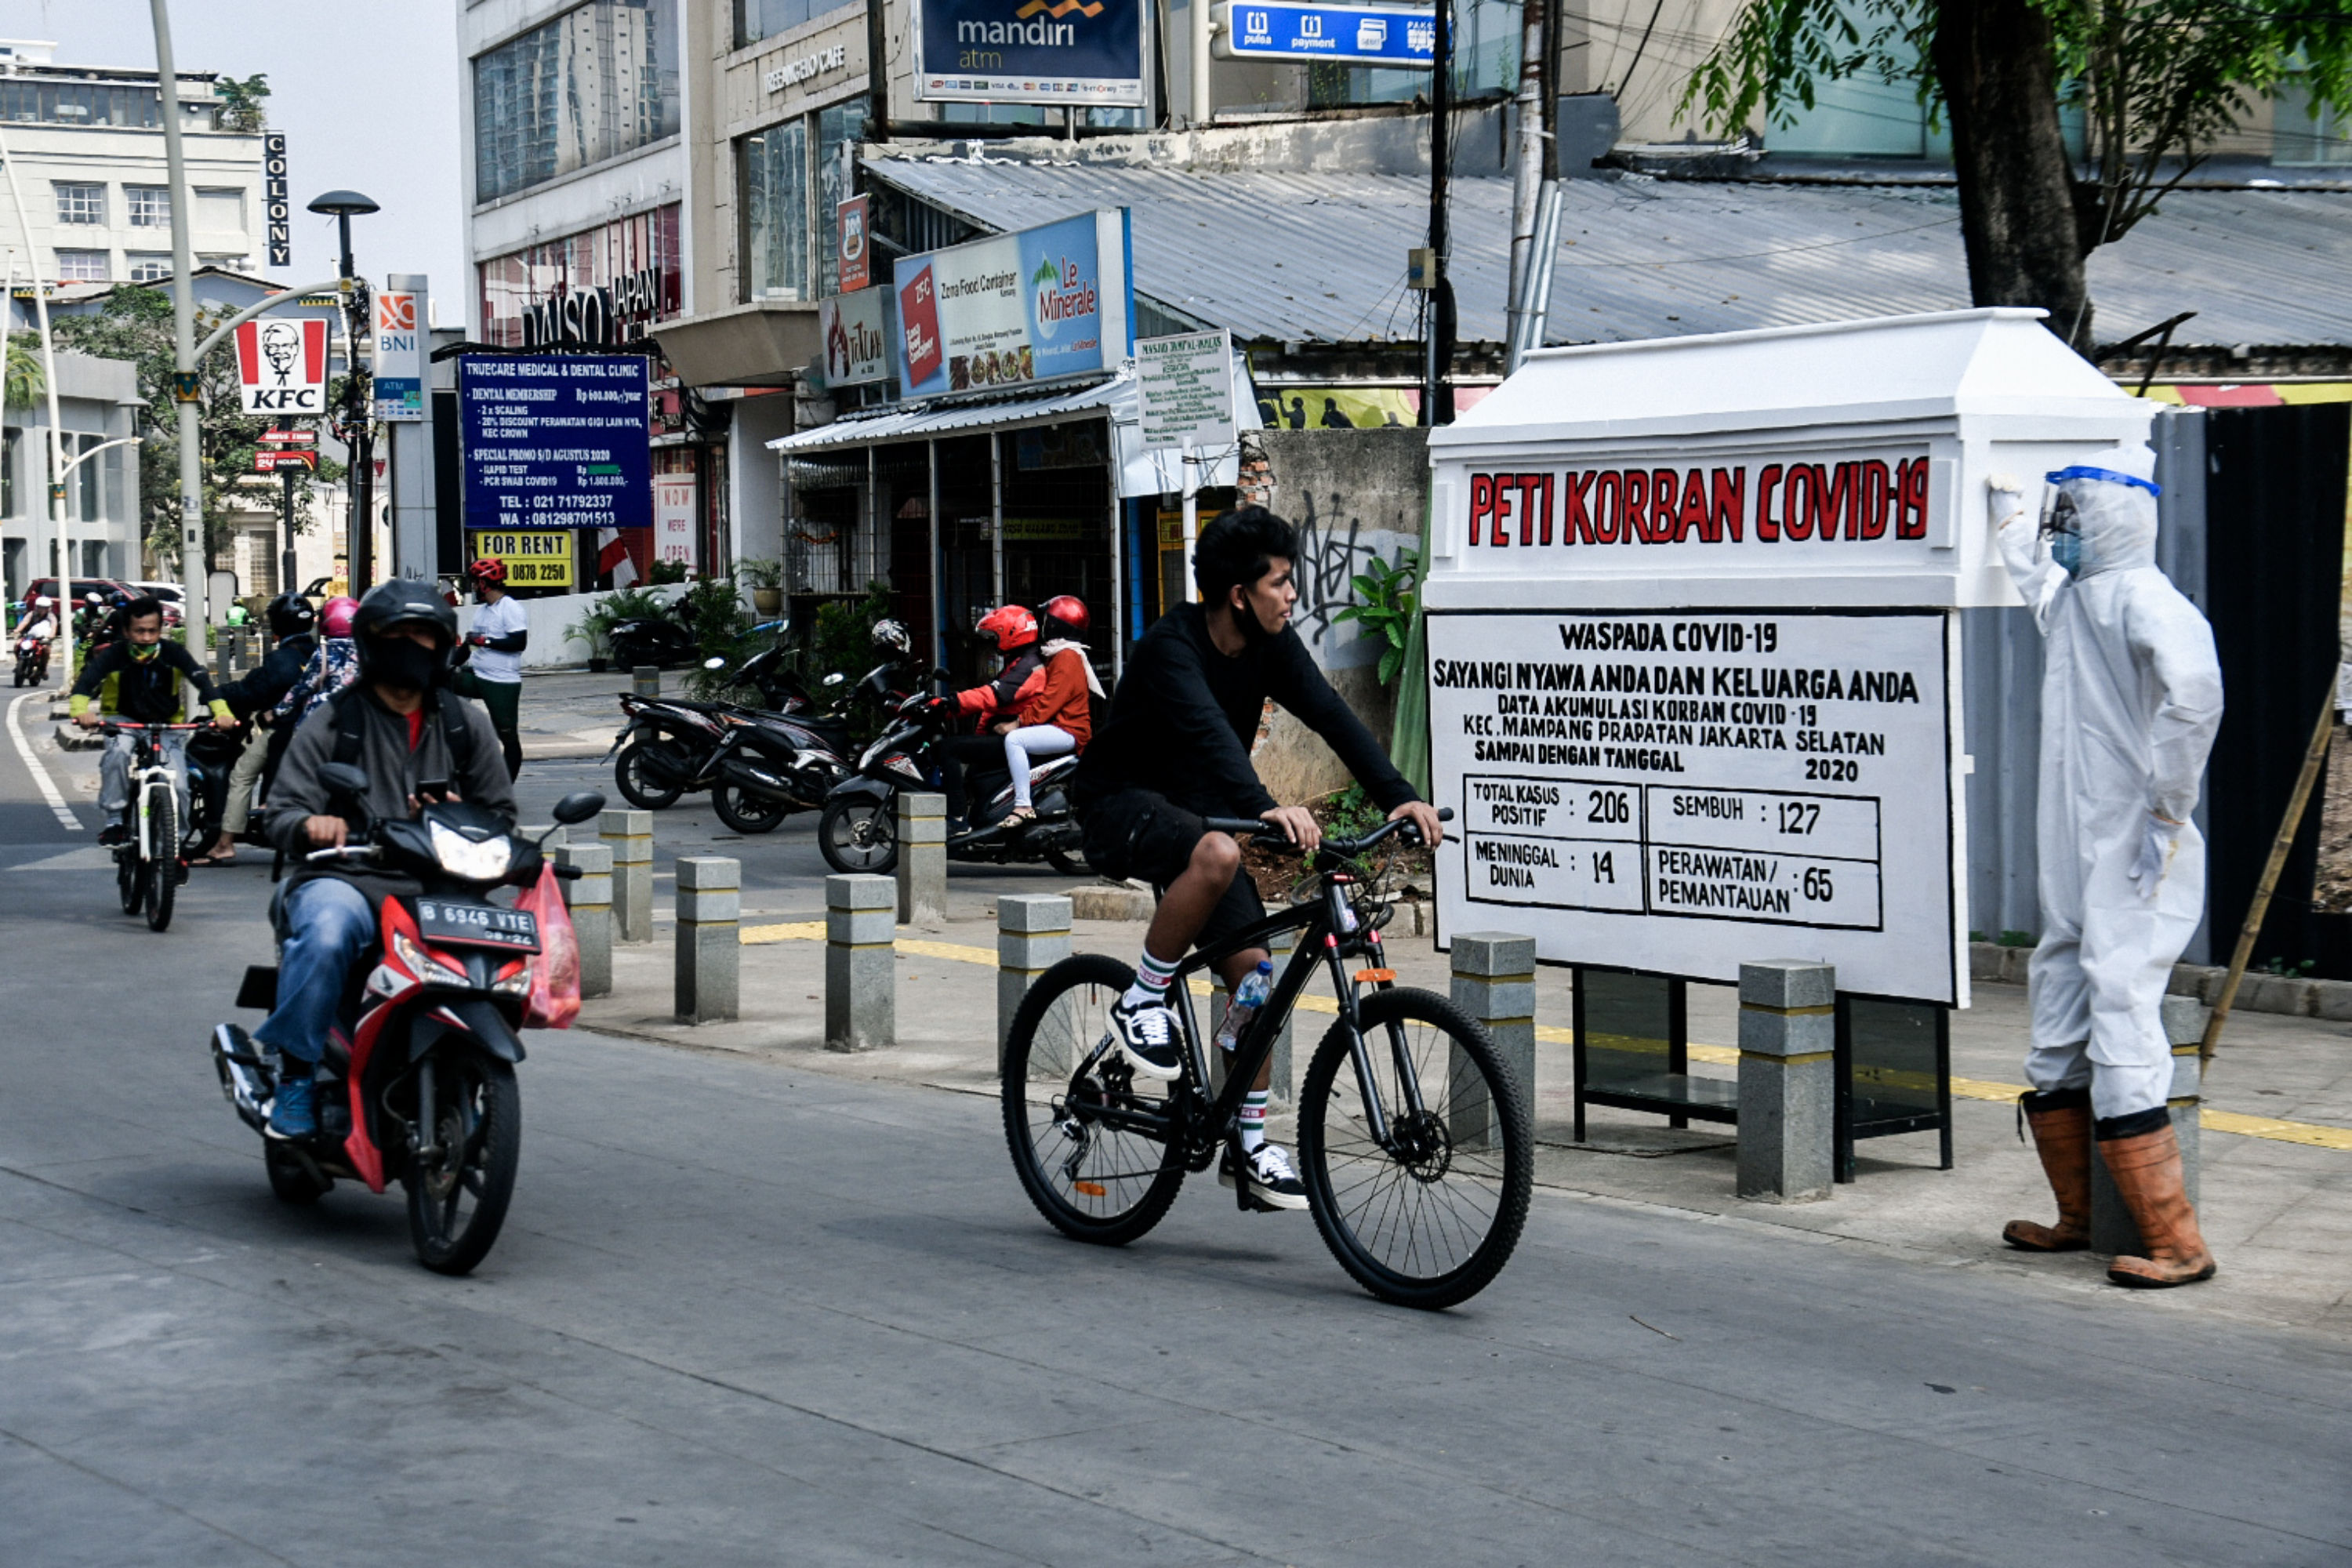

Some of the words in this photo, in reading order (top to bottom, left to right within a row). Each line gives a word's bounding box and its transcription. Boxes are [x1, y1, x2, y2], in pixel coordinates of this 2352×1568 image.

[958, 16, 1074, 45] mandiri
[1244, 35, 1272, 45] pulsa
[1291, 38, 1335, 49] payment
[819, 44, 844, 74] CAFE
[960, 49, 1002, 68] atm
[268, 137, 288, 263] COLONY
[941, 282, 960, 299] Zona
[960, 278, 978, 296] Food
[979, 270, 1017, 292] Container
[1062, 256, 1078, 289] Le
[610, 269, 656, 316] JAPAN
[916, 276, 931, 304] ZFC
[1040, 281, 1096, 323] Minerale
[521, 288, 604, 354] DAISO
[381, 336, 414, 351] BNI
[466, 363, 516, 376] TRUECARE
[518, 363, 559, 376] MEDICAL
[561, 364, 568, 376] &
[571, 365, 606, 376] DENTAL
[608, 365, 639, 377] CLINIC
[383, 381, 405, 390] ATM
[472, 388, 504, 401] DENTAL
[506, 388, 557, 401] MEMBERSHIP
[575, 388, 587, 404] Rp
[252, 389, 316, 408] KFC
[495, 405, 528, 415] SCALING
[482, 428, 499, 438] KEC
[499, 429, 528, 438] CROWN
[499, 417, 539, 426] DISCOUNT
[540, 417, 586, 426] PERAWATAN
[587, 417, 604, 426] GIGI
[606, 417, 623, 426] LAIN
[257, 459, 275, 468] 24
[474, 449, 507, 461] SPECIAL
[509, 449, 535, 461] PROMO
[552, 449, 590, 461] AGUSTUS
[590, 450, 611, 461] 2020
[484, 465, 507, 474] RAPID
[509, 465, 528, 474] TEST
[484, 476, 500, 486] PCR
[501, 476, 524, 486] SWAB
[578, 477, 587, 488] Rp
[499, 495, 522, 508] TEL
[533, 495, 554, 508] 021
[557, 495, 613, 508] 71792337
[665, 488, 689, 506] NOW
[1468, 472, 1555, 547] PETI
[1563, 466, 1747, 546] KORBAN
[1755, 456, 1930, 544] COVID-19
[499, 513, 520, 524] WA
[484, 535, 516, 554] FOR
[521, 535, 564, 554] RENT
[665, 545, 690, 563] OPEN
[513, 564, 537, 580] 0878
[540, 564, 565, 580] 2250
[1558, 622, 1668, 652] WASPADA
[1672, 622, 1778, 653] COVID-19
[1433, 659, 1512, 689] SAYANGI
[1516, 662, 1586, 691] NYAWA
[1590, 665, 1652, 693] ANDA
[1654, 666, 1705, 696] DAN
[1712, 667, 1844, 700] KELUARGA
[1846, 670, 1920, 704] ANDA
[1498, 694, 1539, 715] DATA
[1544, 696, 1648, 720] AKUMULASI
[1653, 699, 1726, 723] KORBAN
[1502, 716, 1593, 741] MAMPANG
[1598, 721, 1693, 746] PRAPATAN
[1699, 726, 1788, 750] JAKARTA
[1795, 730, 1885, 756] SELATAN
[1475, 740, 1535, 764] SAMPAI
[1537, 743, 1600, 767] DENGAN
[1603, 747, 1685, 772] TANGGAL
[1805, 758, 1860, 782] 2020
[1473, 782, 1514, 802] TOTAL
[1515, 785, 1560, 806] KASUS
[1588, 789, 1629, 824] 206
[1672, 794, 1744, 820] SEMBUH
[1778, 801, 1821, 835] 127
[1491, 804, 1548, 827] POSITIF
[1475, 840, 1560, 869] MENINGGAL
[1592, 850, 1616, 884] 14
[1490, 864, 1535, 889] DUNIA
[1803, 866, 1834, 902] 65
[1658, 877, 1790, 914] PEMANTAUAN
[422, 906, 435, 920] B
[445, 907, 489, 925] 6946
[496, 913, 530, 931] VTE
